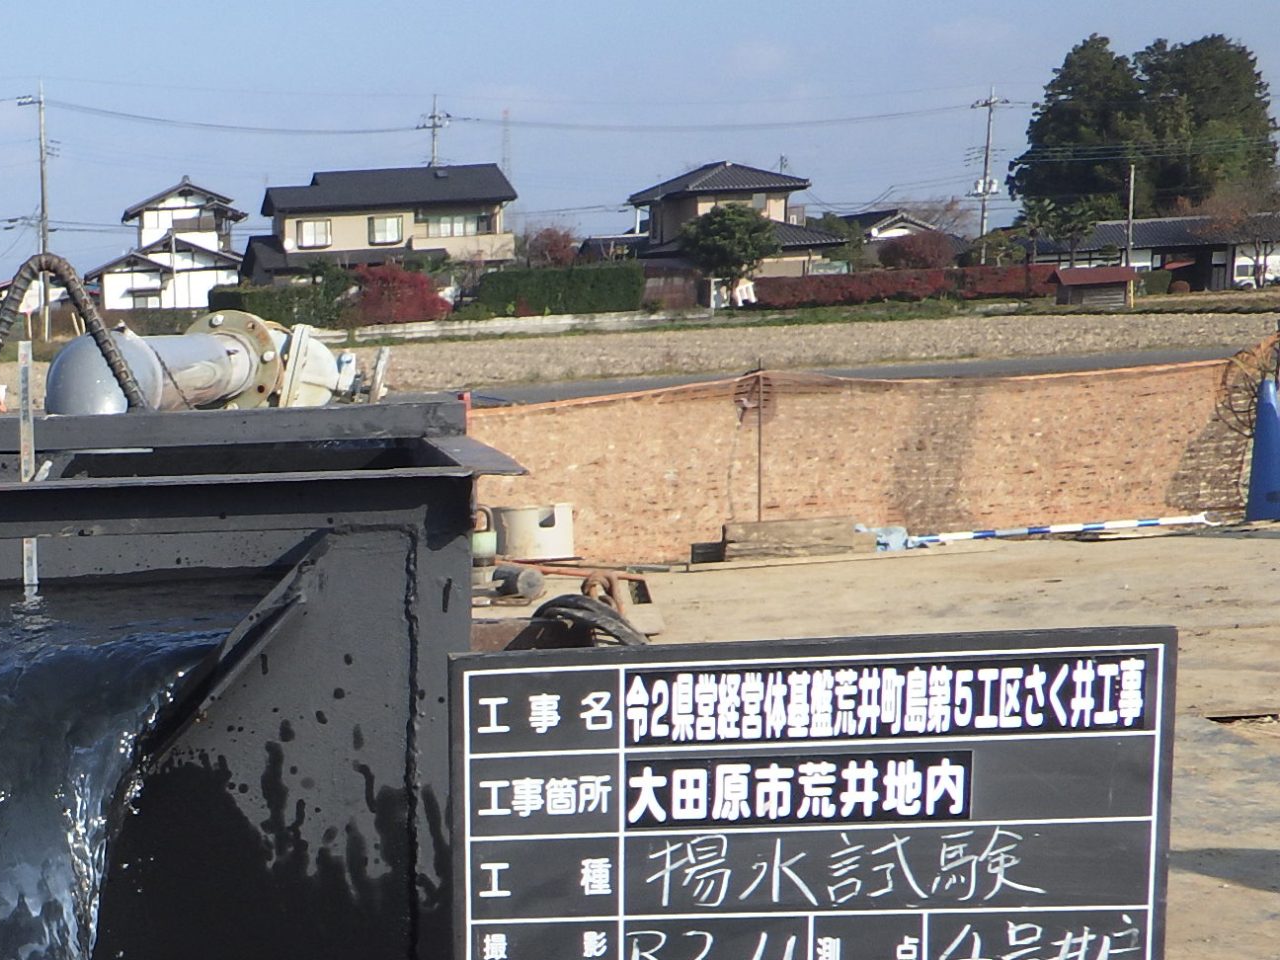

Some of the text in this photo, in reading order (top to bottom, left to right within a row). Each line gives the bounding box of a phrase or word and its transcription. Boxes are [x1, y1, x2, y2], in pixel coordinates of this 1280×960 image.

[477, 691, 613, 734] 工事名
[477, 775, 612, 817] 工事箇所
[628, 758, 964, 823] 大田原市荒井地内
[479, 858, 612, 898] 工種
[645, 826, 1047, 907] 揚水試験
[483, 931, 607, 960] 撮影
